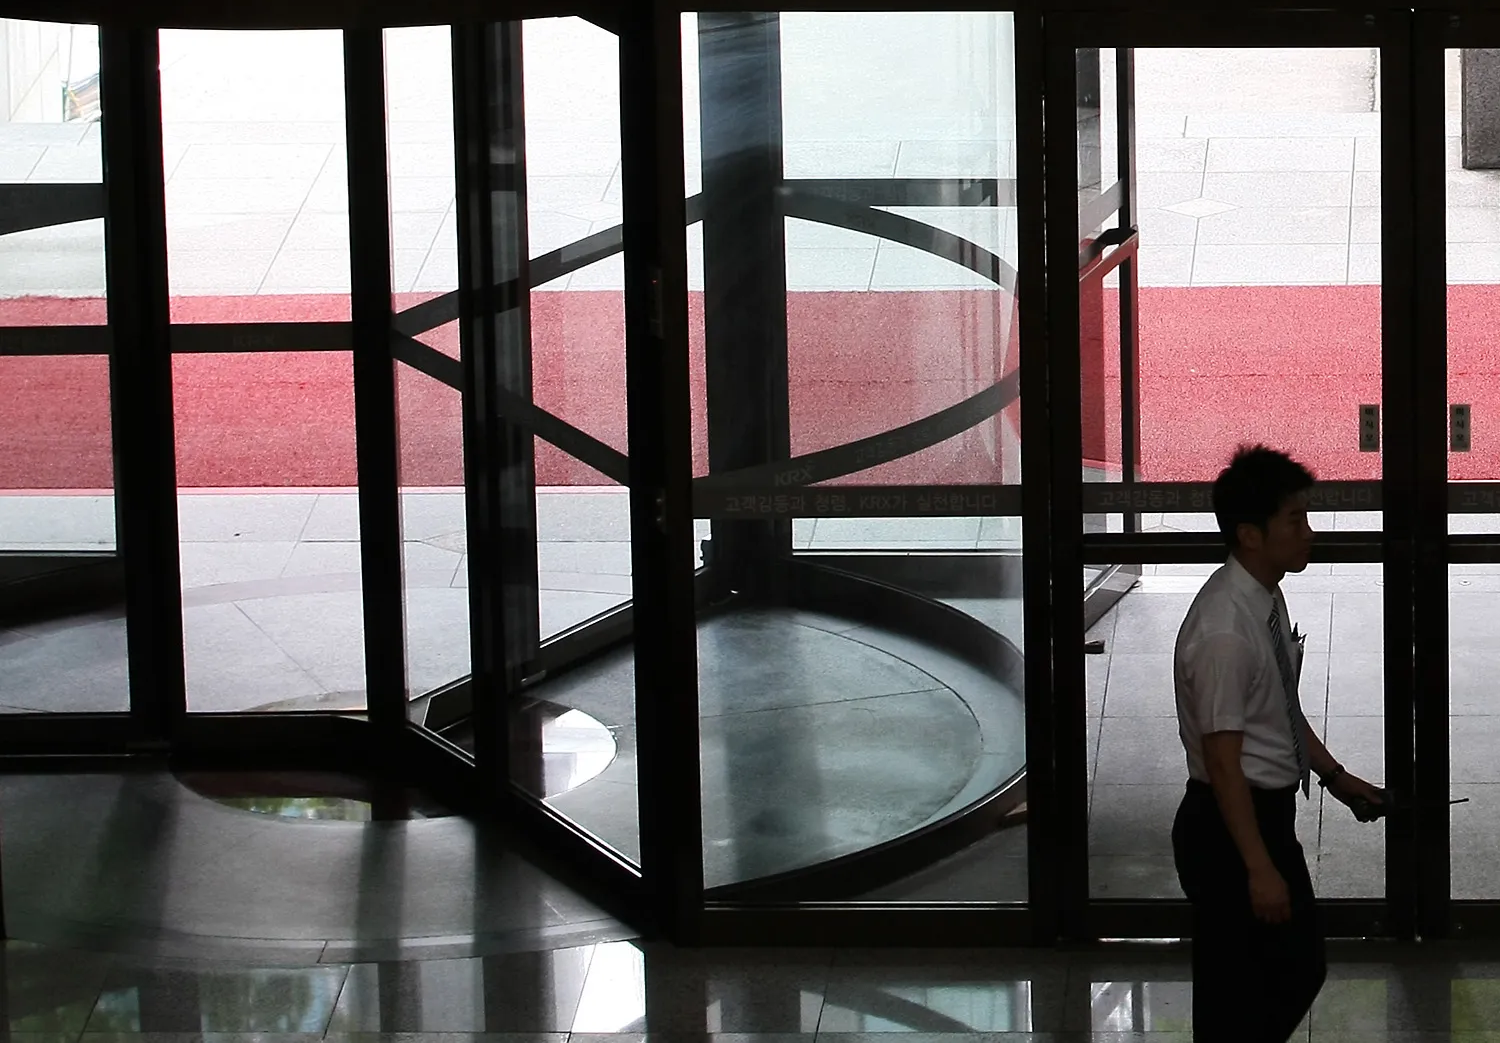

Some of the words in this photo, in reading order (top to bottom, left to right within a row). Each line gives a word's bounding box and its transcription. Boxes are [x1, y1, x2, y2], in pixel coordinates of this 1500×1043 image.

[774, 466, 813, 487] KRX
[859, 495, 908, 512] KRX가
[916, 493, 998, 512] 실천합니다
